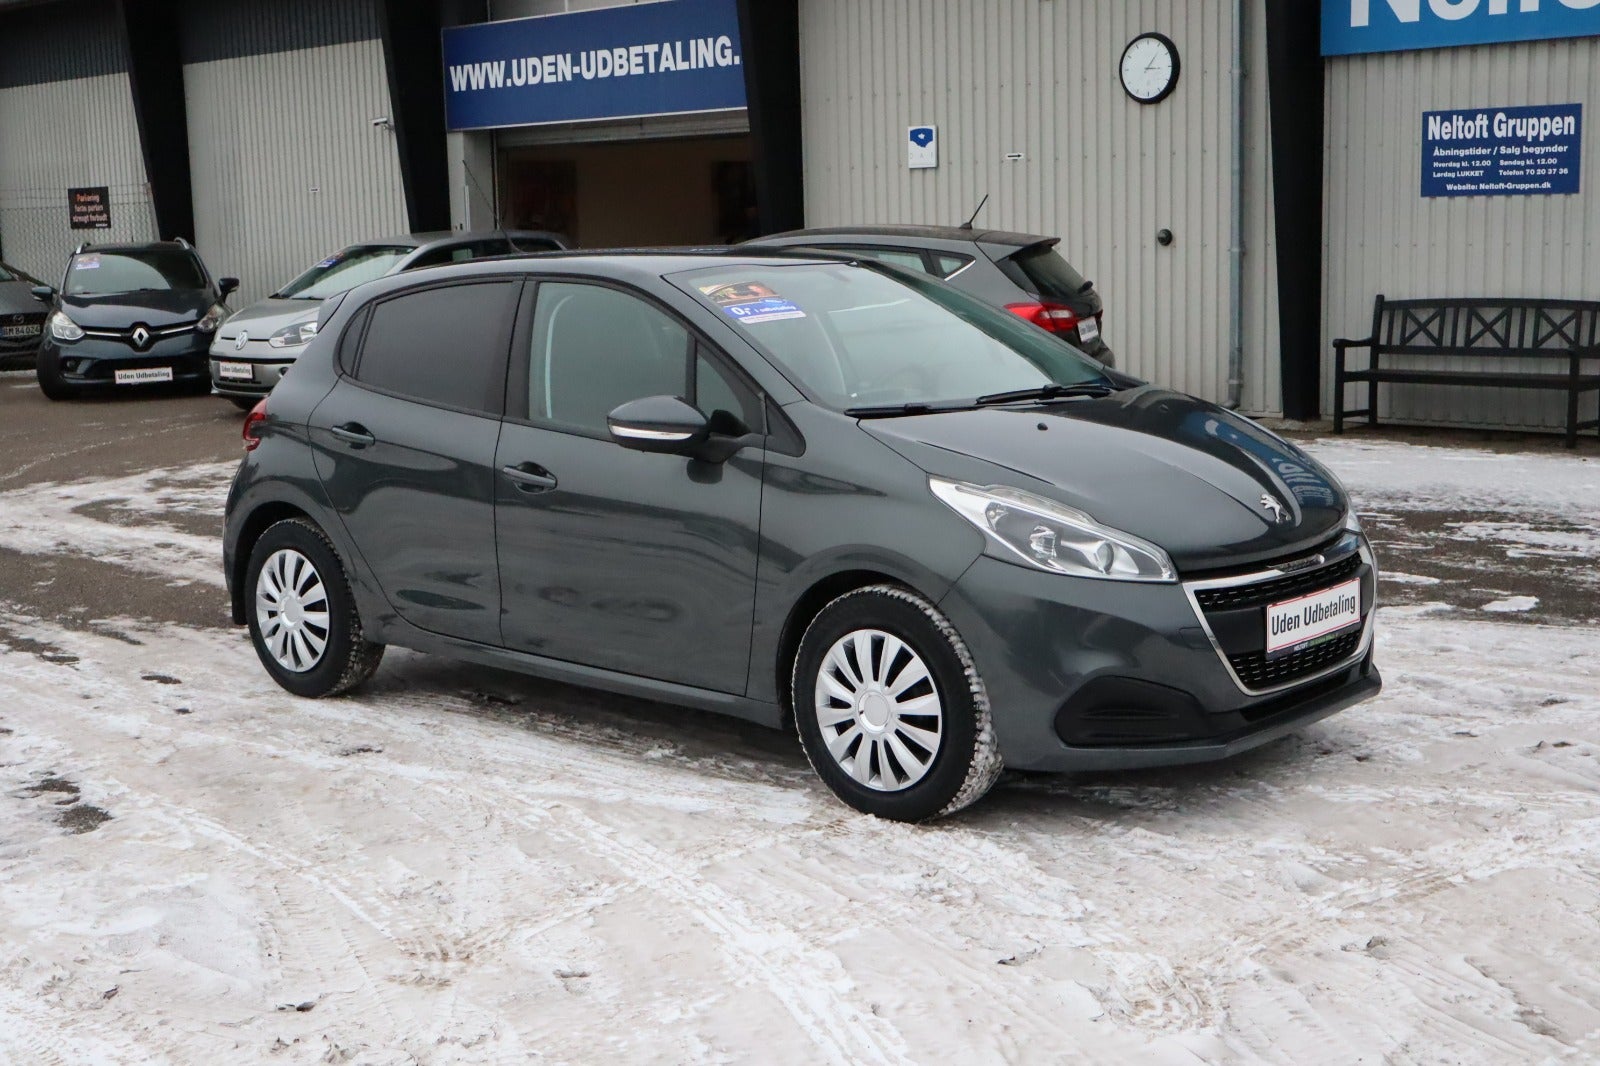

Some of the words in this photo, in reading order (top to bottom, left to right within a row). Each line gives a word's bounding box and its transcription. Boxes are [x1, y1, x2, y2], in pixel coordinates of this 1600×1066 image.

[450, 35, 742, 92] WWW.UDEN-UDBETALING.
[1427, 114, 1489, 141] Neltoft
[1493, 112, 1575, 141] Gruppen
[1433, 146, 1491, 157] Åbningstider
[1500, 146, 1520, 155] Salg
[1523, 144, 1568, 154] begynder
[1446, 183, 1478, 191] Website:
[1480, 182, 1551, 190] Neltoft-Gruppen.dk
[136, 371, 170, 380] Udbetaling
[1271, 613, 1300, 636] Uden
[1303, 594, 1356, 626] Udbetaling
